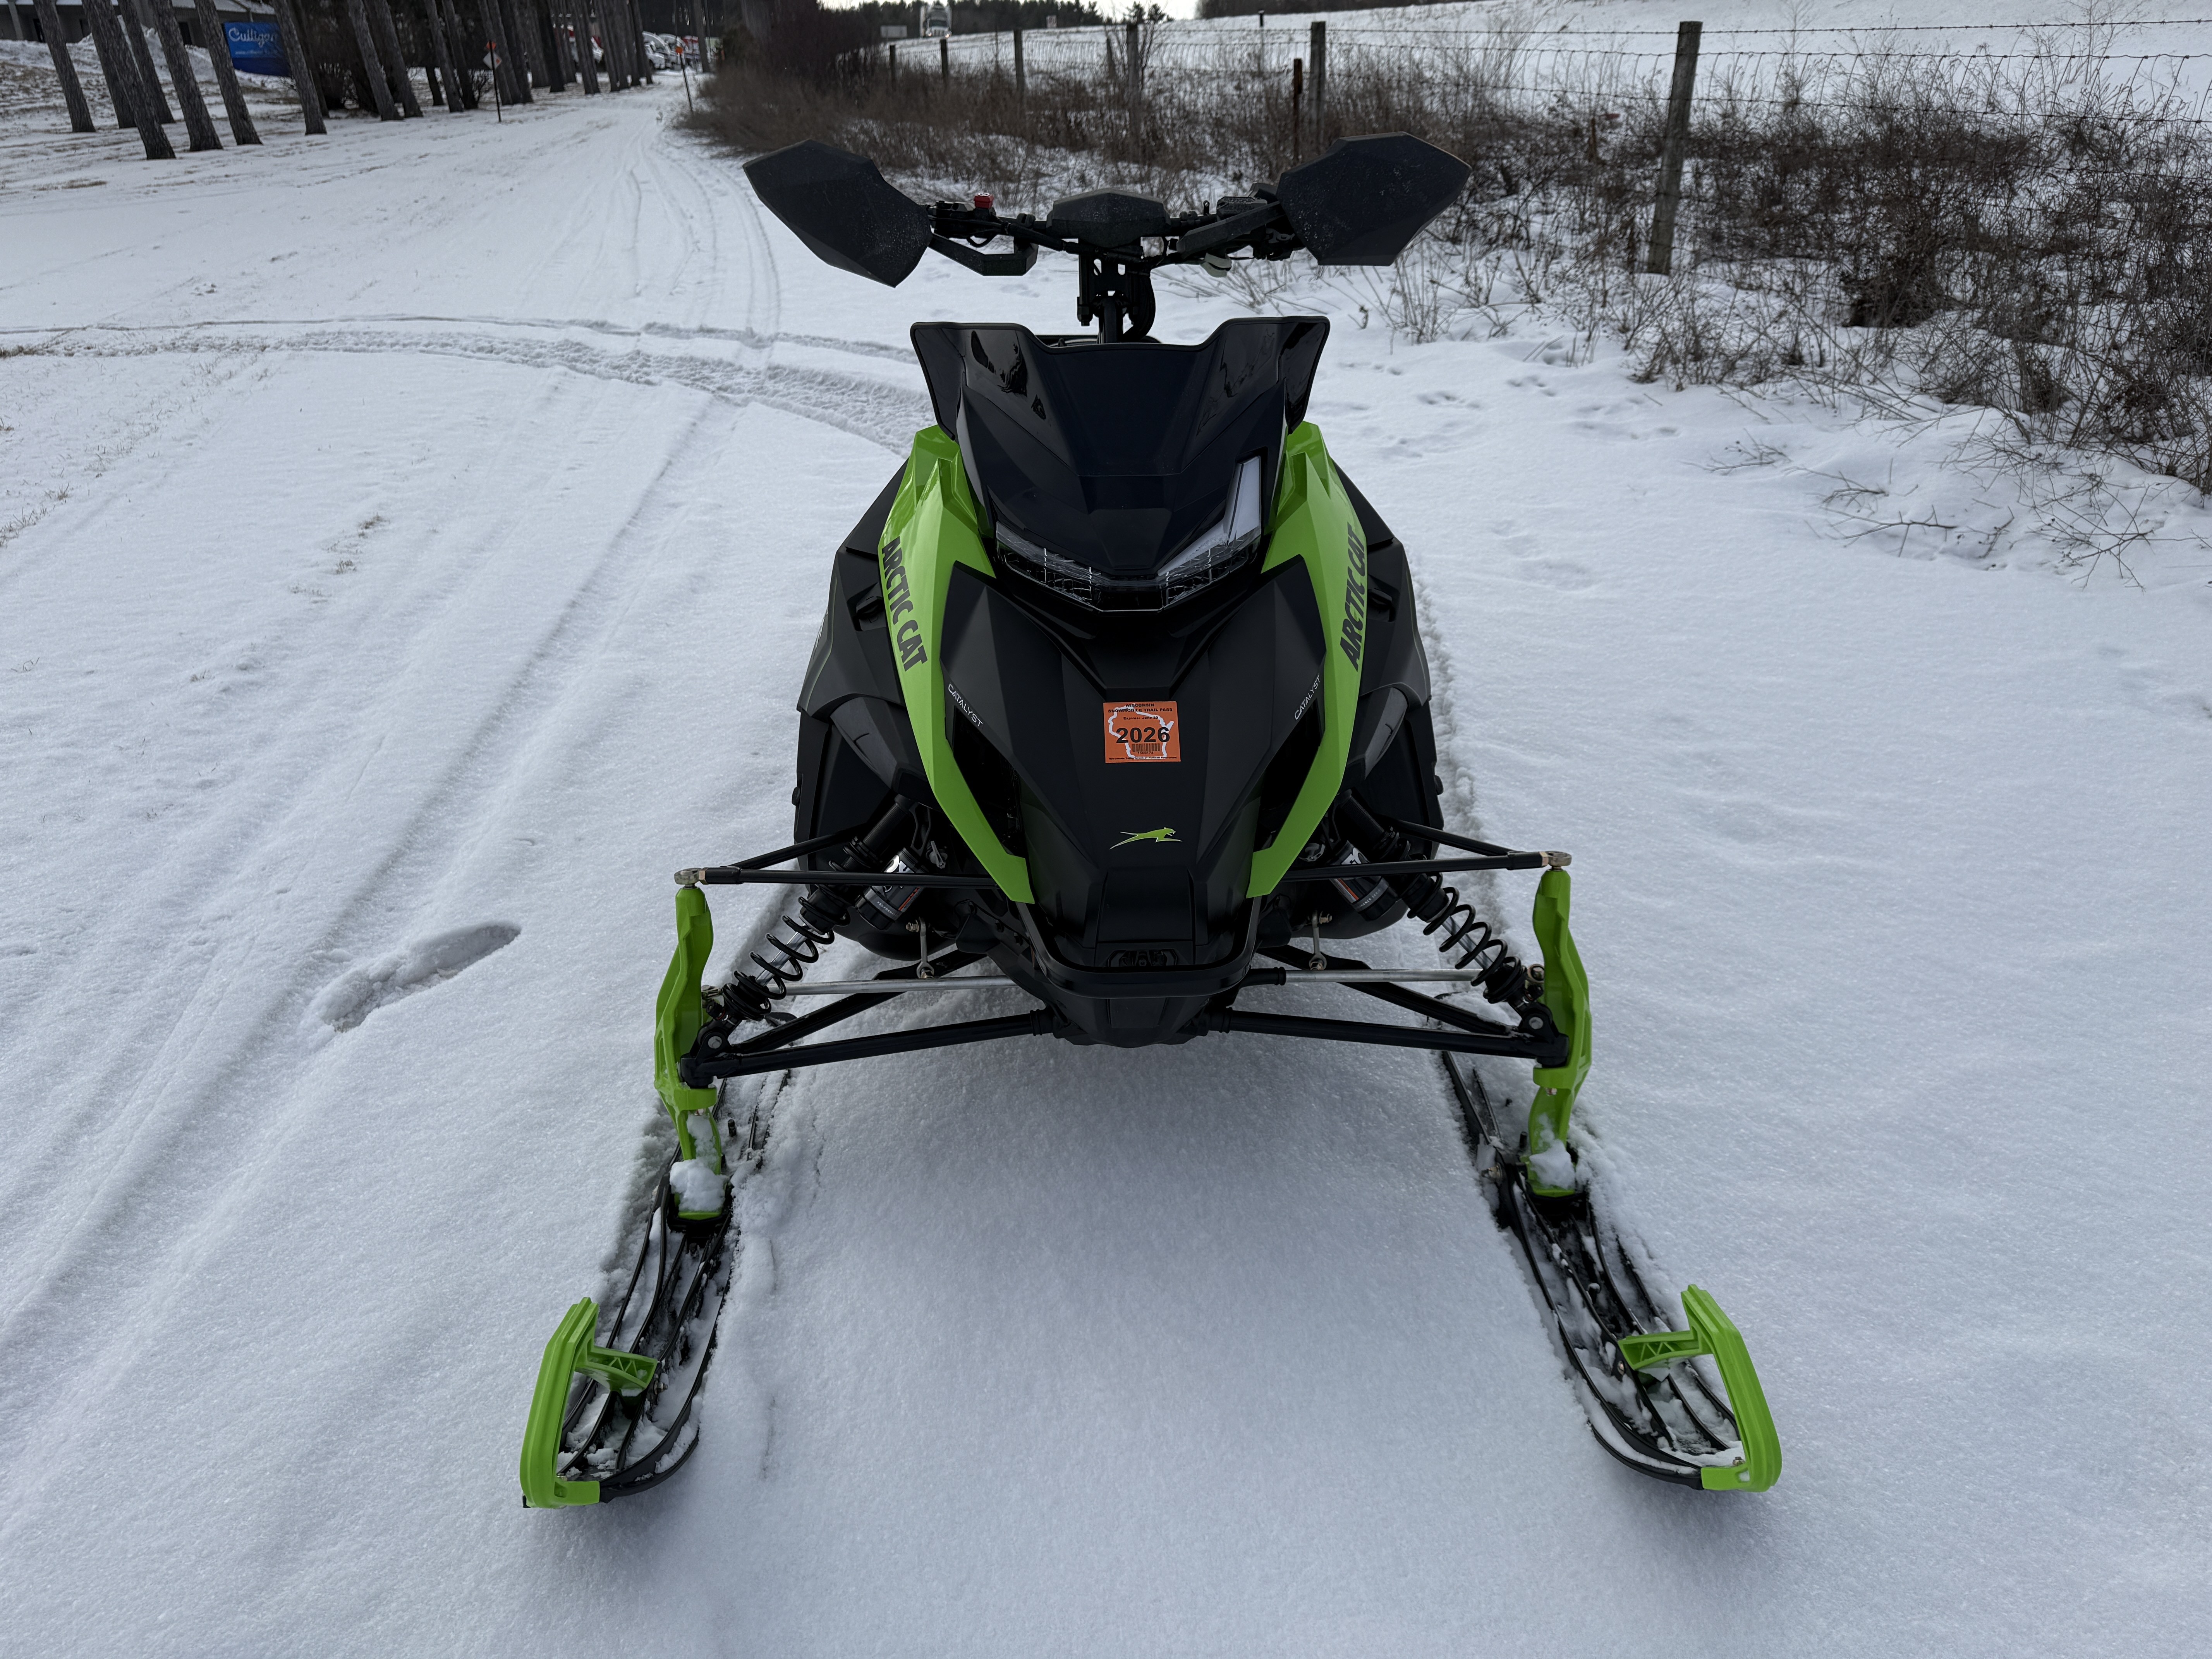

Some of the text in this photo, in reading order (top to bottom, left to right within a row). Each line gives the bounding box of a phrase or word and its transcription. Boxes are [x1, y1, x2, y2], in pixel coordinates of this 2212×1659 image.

[881, 536, 928, 672] ARCTIC CAT
[1340, 522, 1366, 672] ARCTIC CAT
[948, 684, 983, 727] CATALYST
[1295, 675, 1321, 720] CATALYST
[1116, 727, 1170, 743] 2026
